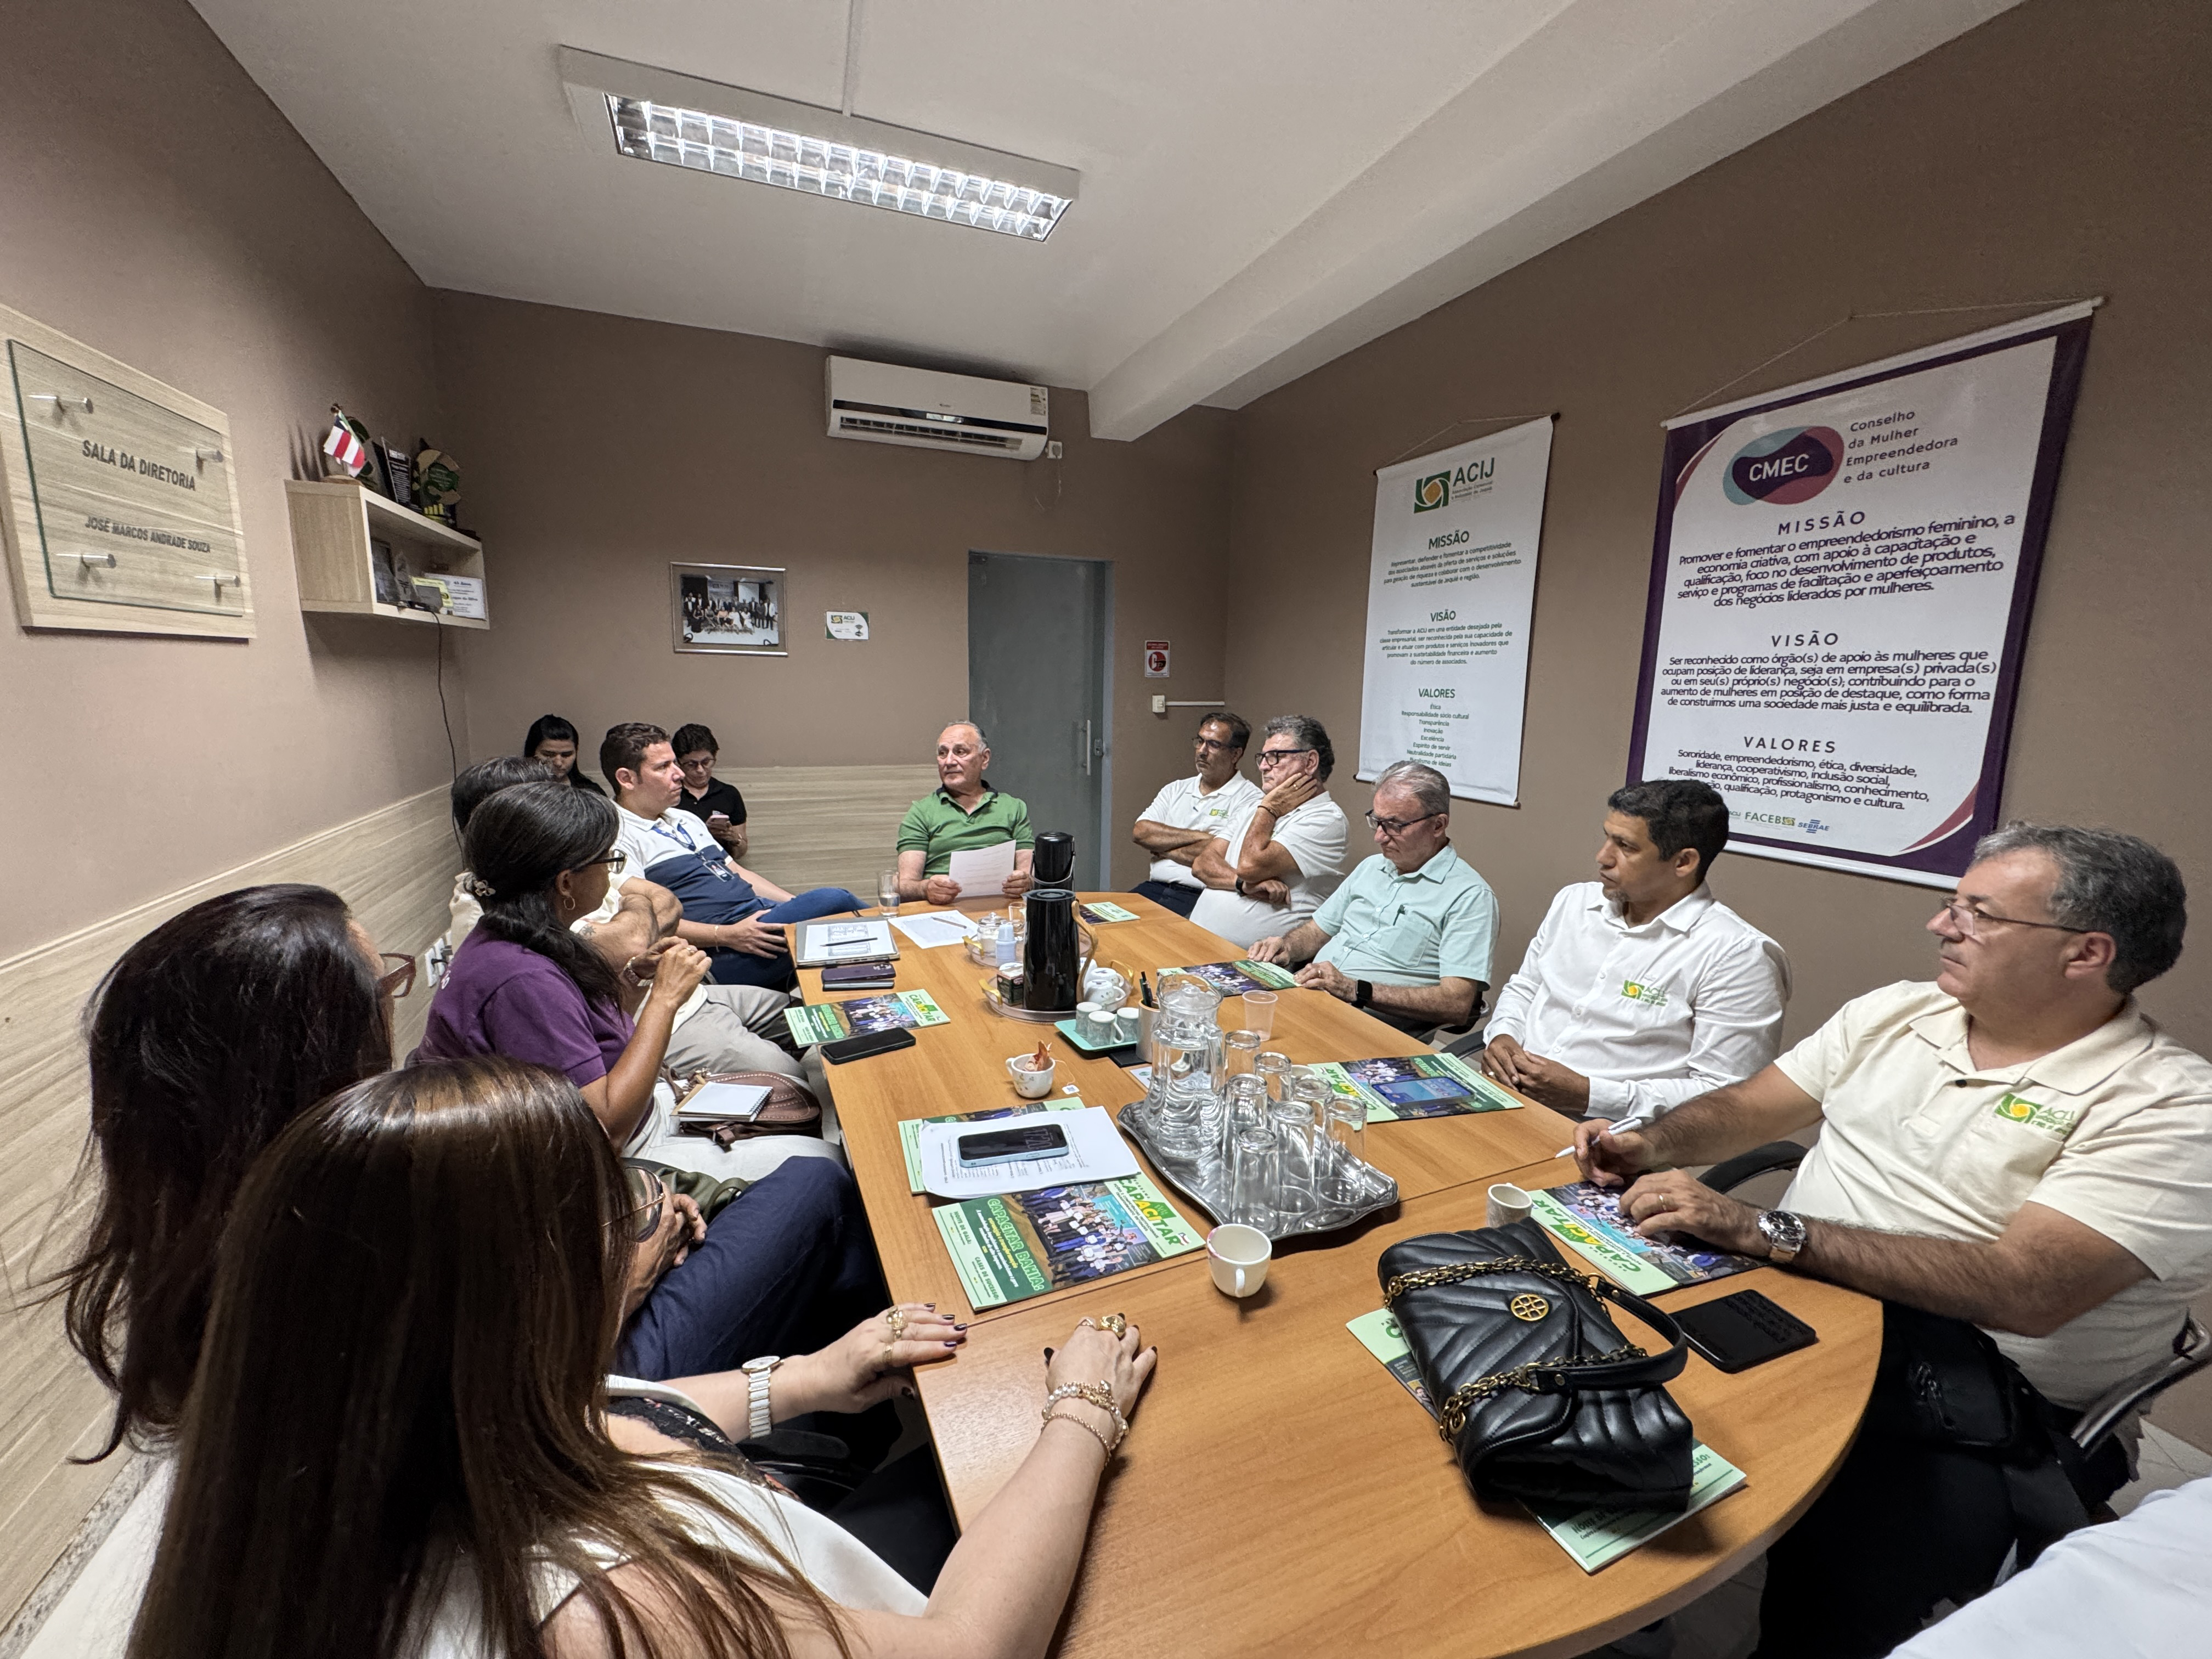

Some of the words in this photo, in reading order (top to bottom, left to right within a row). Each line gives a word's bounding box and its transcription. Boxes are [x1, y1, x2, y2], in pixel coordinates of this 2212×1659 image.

[1850, 411, 1915, 431] Conselho
[1848, 439, 1864, 449] da
[1870, 428, 1918, 444] Mulher
[1846, 438, 1957, 466] Empreendedora
[82, 439, 116, 465] SALA
[120, 452, 136, 472] DA
[139, 458, 196, 492] DIRETORIA
[1453, 458, 1494, 486] ACIJ
[1748, 453, 1810, 481] CMEC
[1857, 471, 1872, 481] da
[1878, 462, 1929, 477] cultura
[1778, 511, 1865, 534] MISSÃO
[112, 522, 149, 542] MARCOS
[150, 532, 187, 550] ANDRADE
[188, 539, 211, 553] SOUZA
[1429, 529, 1469, 549] MISSÃO
[1679, 552, 1724, 565] Promover
[1735, 544, 1786, 557] fomentar
[1787, 543, 1796, 551] o
[1799, 527, 1925, 550] empreendedorismo
[1928, 516, 1998, 535] feminino,
[2004, 515, 2015, 525] a
[1697, 559, 1747, 573] economia
[1750, 555, 1790, 570] criativa,
[1793, 552, 1819, 563] com
[1823, 546, 1859, 561] apoio
[1875, 534, 1961, 554] capacitação
[1965, 534, 1977, 544] e
[1677, 587, 1708, 599] serviço
[1720, 582, 1778, 597] programas
[1780, 578, 1796, 589] de
[1798, 573, 1860, 591] facilitação
[1864, 573, 1873, 582] e
[1877, 561, 2003, 583] aperfeiçoamento
[1684, 572, 1742, 588] qualificação,
[1746, 570, 1769, 580] foco
[1771, 569, 1787, 578] no
[1790, 556, 1897, 575] desenvolvimento
[1900, 552, 1918, 565] de
[1921, 547, 1995, 566] produtos,
[1713, 596, 1733, 606] dos
[1736, 592, 1784, 607] negócios
[1787, 588, 1841, 601] liderados
[1844, 587, 1866, 599] por
[1869, 582, 1933, 595] mulheres.
[1430, 609, 1455, 622] VISÃO
[1771, 630, 1838, 646] VISÃO
[1662, 668, 1694, 676] ocupam
[1696, 665, 1731, 676] posição
[1734, 665, 1747, 674] de
[1749, 664, 1797, 676] liderança,
[1800, 664, 1822, 676] seja
[1847, 663, 1919, 676] empresa(s)
[1923, 662, 1996, 675] privada(s)
[1669, 657, 1683, 665] Ser
[1684, 654, 1738, 664] reconhecido
[1821, 652, 1837, 662] de
[1839, 651, 1871, 664] apoio
[1874, 651, 1889, 661] às
[1893, 650, 1955, 661] mulheres
[1959, 651, 1988, 663] que
[1418, 688, 1455, 698] VALORES
[1699, 676, 1729, 687] seu(s)
[1731, 676, 1780, 687] próprio(s)
[1848, 676, 1925, 686] contribuindo
[1928, 679, 1960, 690] para
[1700, 686, 1711, 696] de
[1713, 686, 1757, 696] mulheres
[1780, 687, 1821, 699] posição
[1824, 687, 1839, 698] de
[1841, 688, 1901, 701] destaque,
[1906, 691, 1945, 699] como
[1948, 689, 1990, 699] forma
[1667, 696, 1678, 705] de
[1680, 697, 1735, 707] construirmos
[1764, 698, 1818, 709] sociedade
[1821, 699, 1847, 709] mais
[1848, 700, 1879, 712] justa
[1883, 703, 1892, 711] e
[1895, 701, 1971, 713] equilibrada.
[1744, 736, 1835, 753] VALORES
[1678, 749, 1722, 761] Sororidade,
[1724, 755, 1815, 770] empreendedorismo,
[1819, 759, 1846, 773] ética,
[1849, 762, 1916, 777] diversidade,
[1695, 759, 1733, 772] liderança,
[1736, 765, 1808, 778] cooperativismo,
[1811, 769, 1854, 781] inclusão
[1856, 775, 1889, 788] social,
[1711, 771, 1759, 785] econômico,
[1762, 777, 1841, 792] profissionalismo,
[1844, 786, 1928, 802] conhecimento,
[1724, 783, 1778, 797] qualificação,
[1780, 790, 1850, 803] protagonismo
[1864, 798, 1904, 809] cultura.
[1797, 822, 1829, 831] SEBRAE
[1118, 1178, 1182, 1245] CAPACITAR
[988, 1198, 1024, 1252] CAPACITAR
[1015, 1251, 1045, 1291] BAHIA:
[1532, 1199, 1641, 1272] CAPACITAR
[974, 1256, 985, 1270] CASES
[986, 1276, 999, 1300] SUCESSO:
